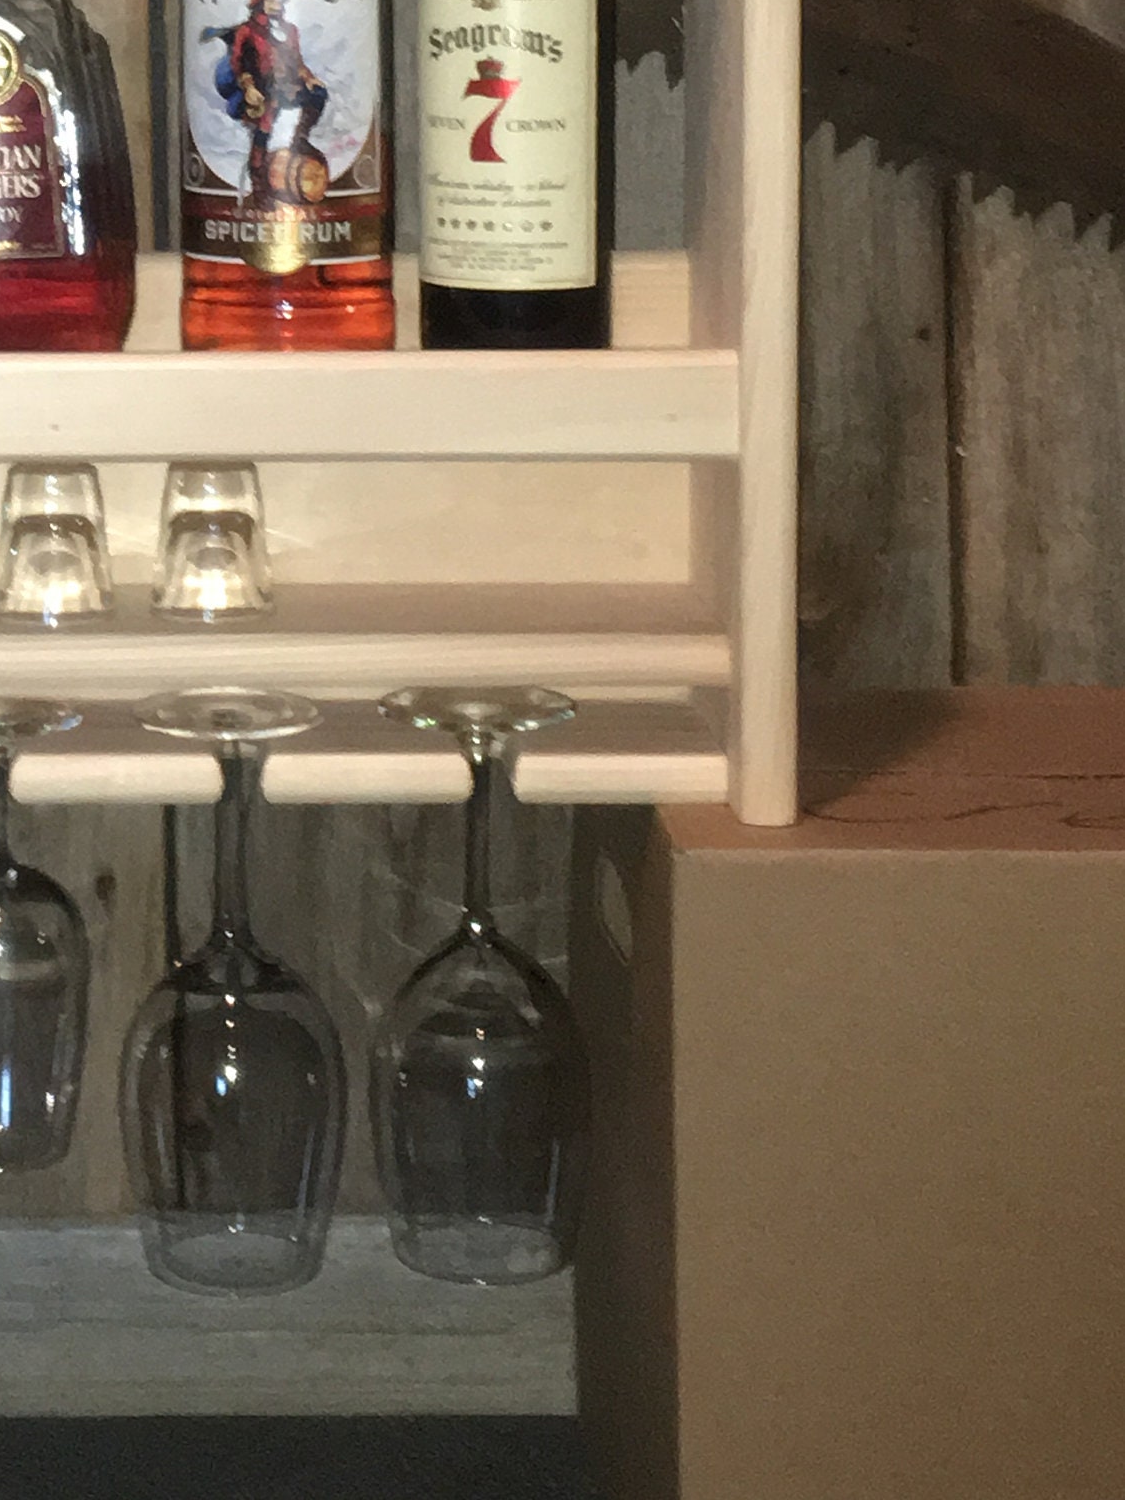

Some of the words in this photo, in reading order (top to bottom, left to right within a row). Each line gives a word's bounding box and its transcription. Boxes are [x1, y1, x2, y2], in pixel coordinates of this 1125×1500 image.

[428, 23, 563, 63] Seagram's
[461, 76, 523, 163] 7
[504, 118, 567, 133] CROWN
[299, 219, 353, 243] RUM
